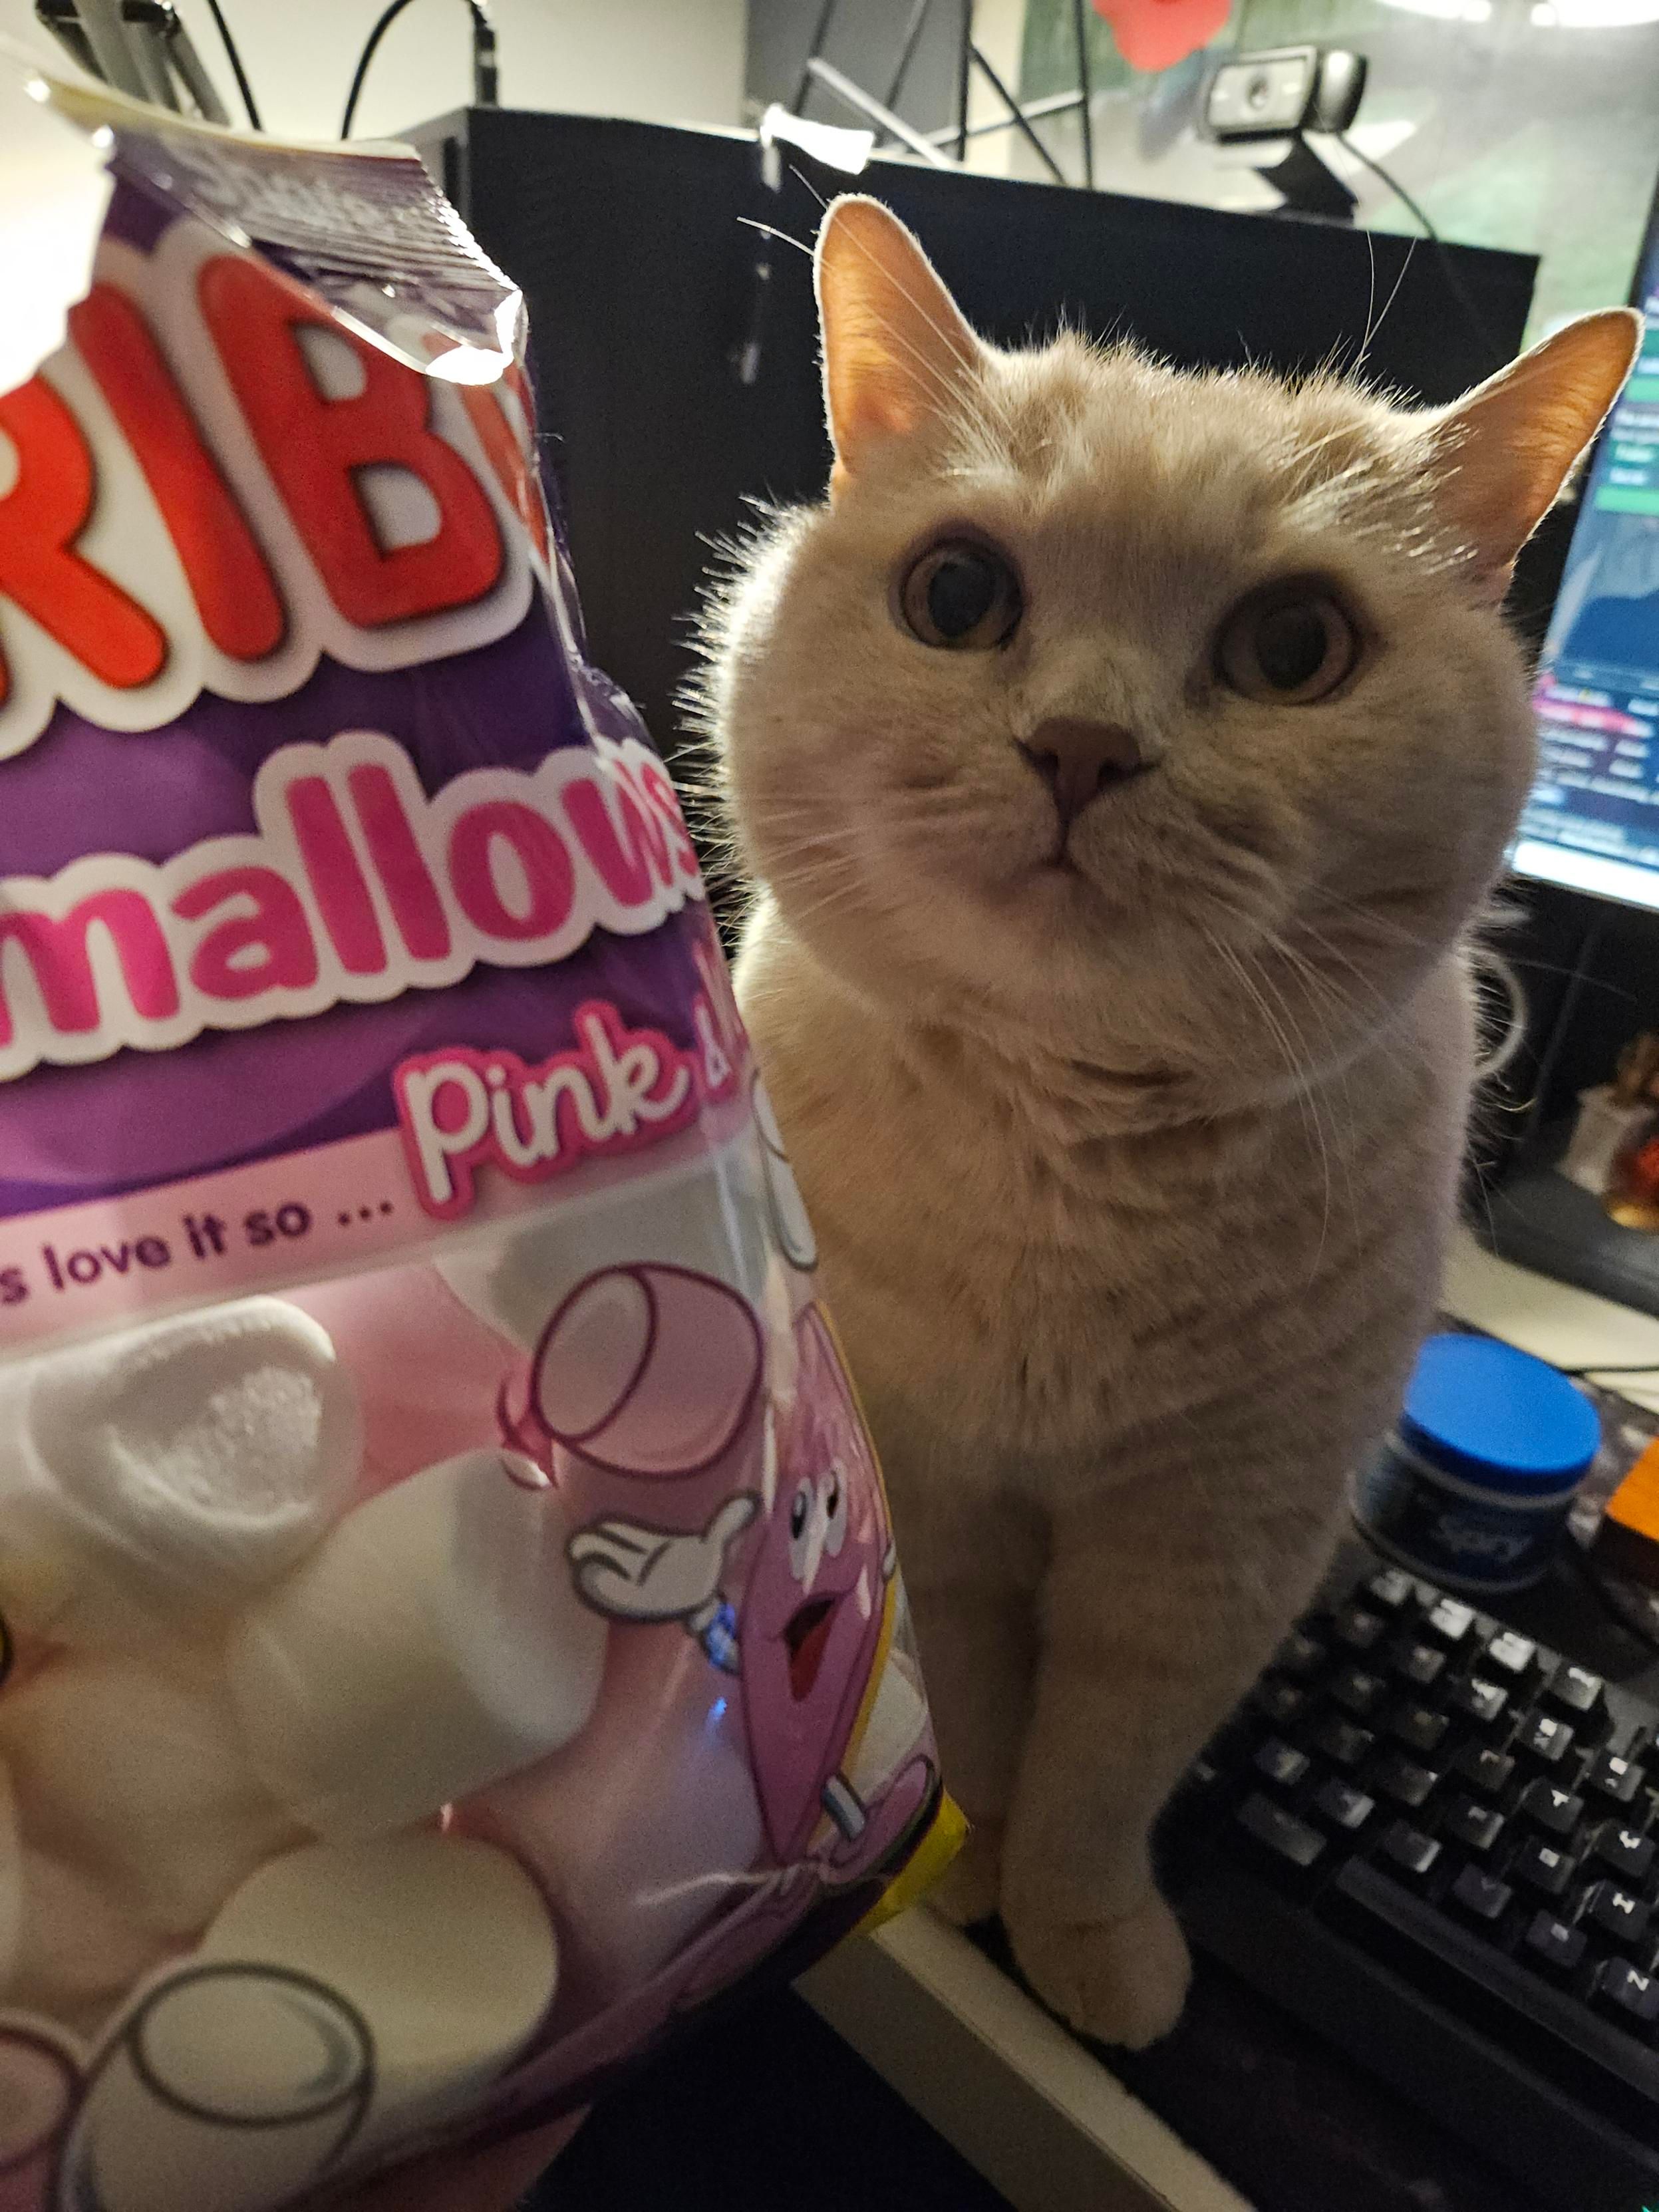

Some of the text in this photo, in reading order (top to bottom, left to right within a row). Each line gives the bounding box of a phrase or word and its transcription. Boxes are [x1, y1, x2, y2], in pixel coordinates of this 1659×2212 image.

[0, 253, 550, 705] RIB
[42, 1235, 172, 1291] love
[243, 1201, 311, 1247] so
